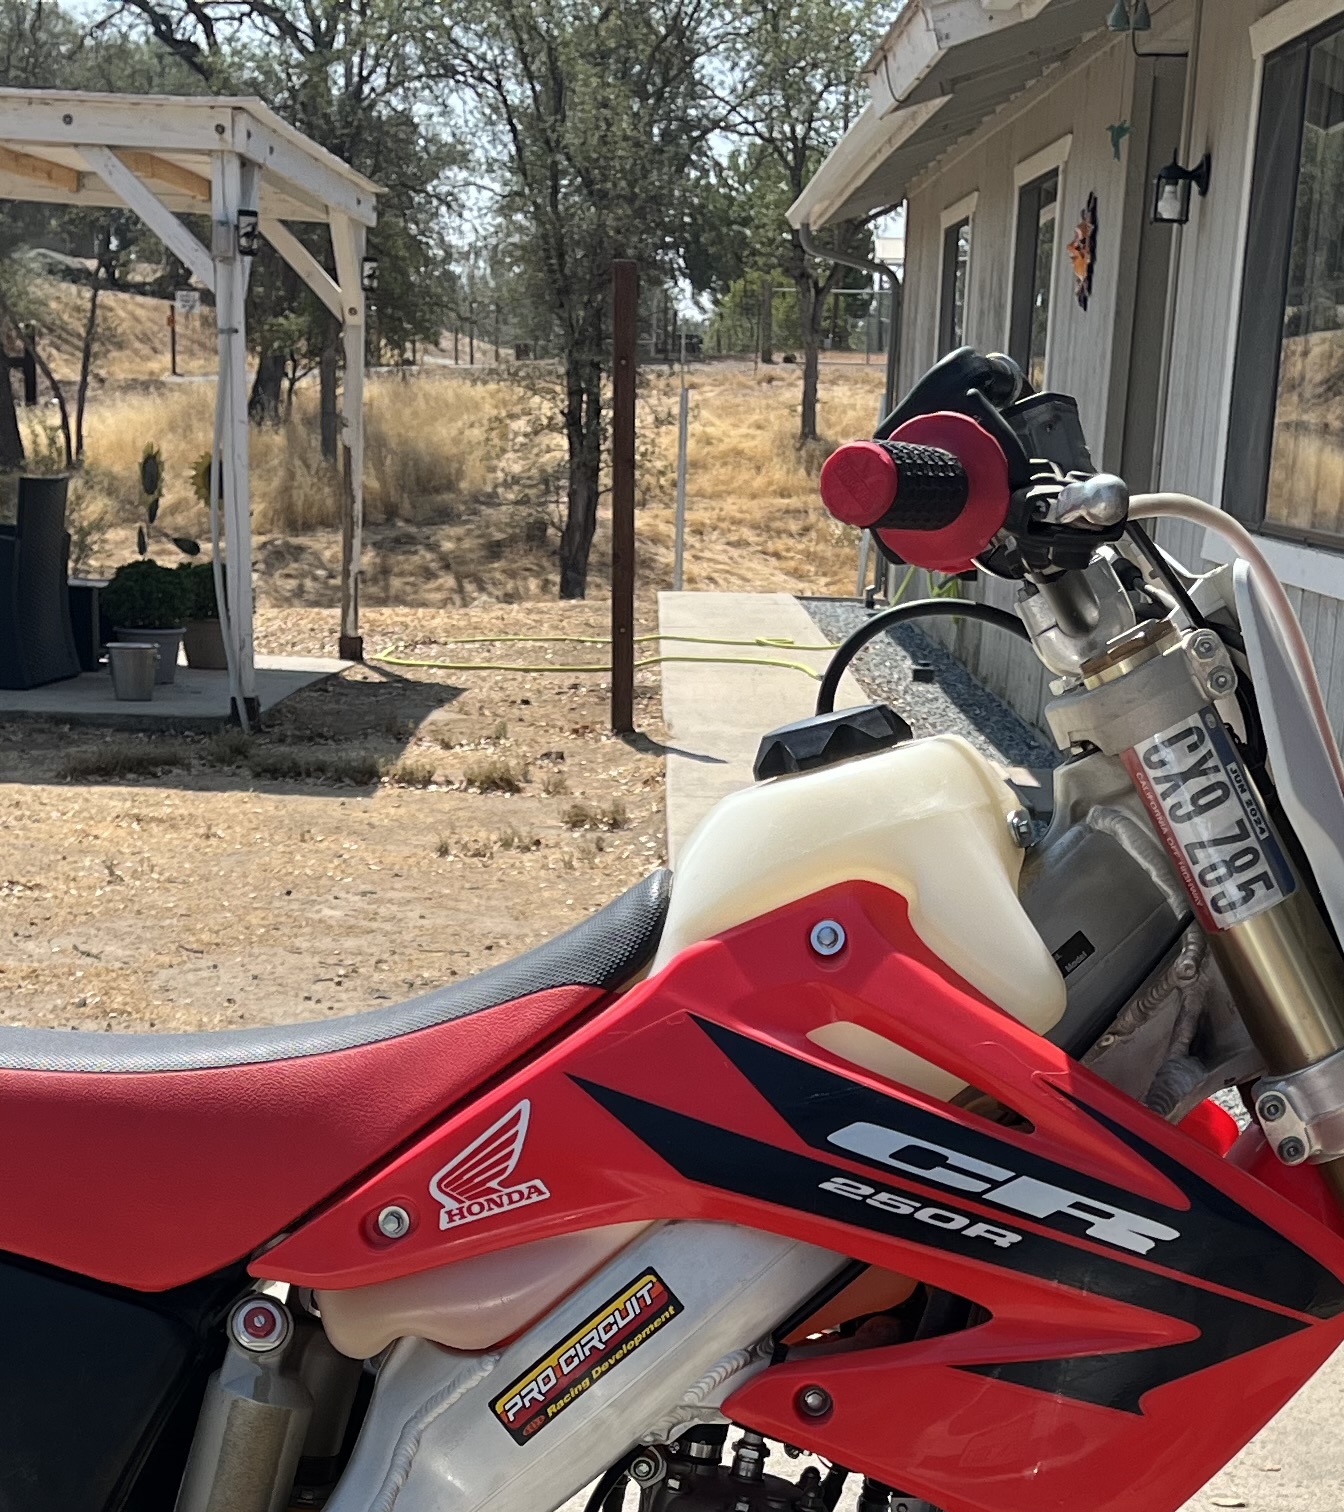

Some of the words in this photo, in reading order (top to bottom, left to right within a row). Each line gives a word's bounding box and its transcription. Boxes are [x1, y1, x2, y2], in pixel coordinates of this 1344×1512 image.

[1135, 771, 1170, 835] CALIFORNIA
[1142, 725, 1231, 825] CX9
[1228, 765, 1247, 795] JUN
[1244, 800, 1267, 836] 2024
[446, 1182, 546, 1225] HONDA
[817, 1176, 1024, 1249] 250R
[826, 1121, 1181, 1256] CR
[503, 1374, 557, 1423] PRO
[558, 1281, 655, 1373] CIRCUIT
[546, 1376, 593, 1419] Racing
[592, 1304, 676, 1381] Development
